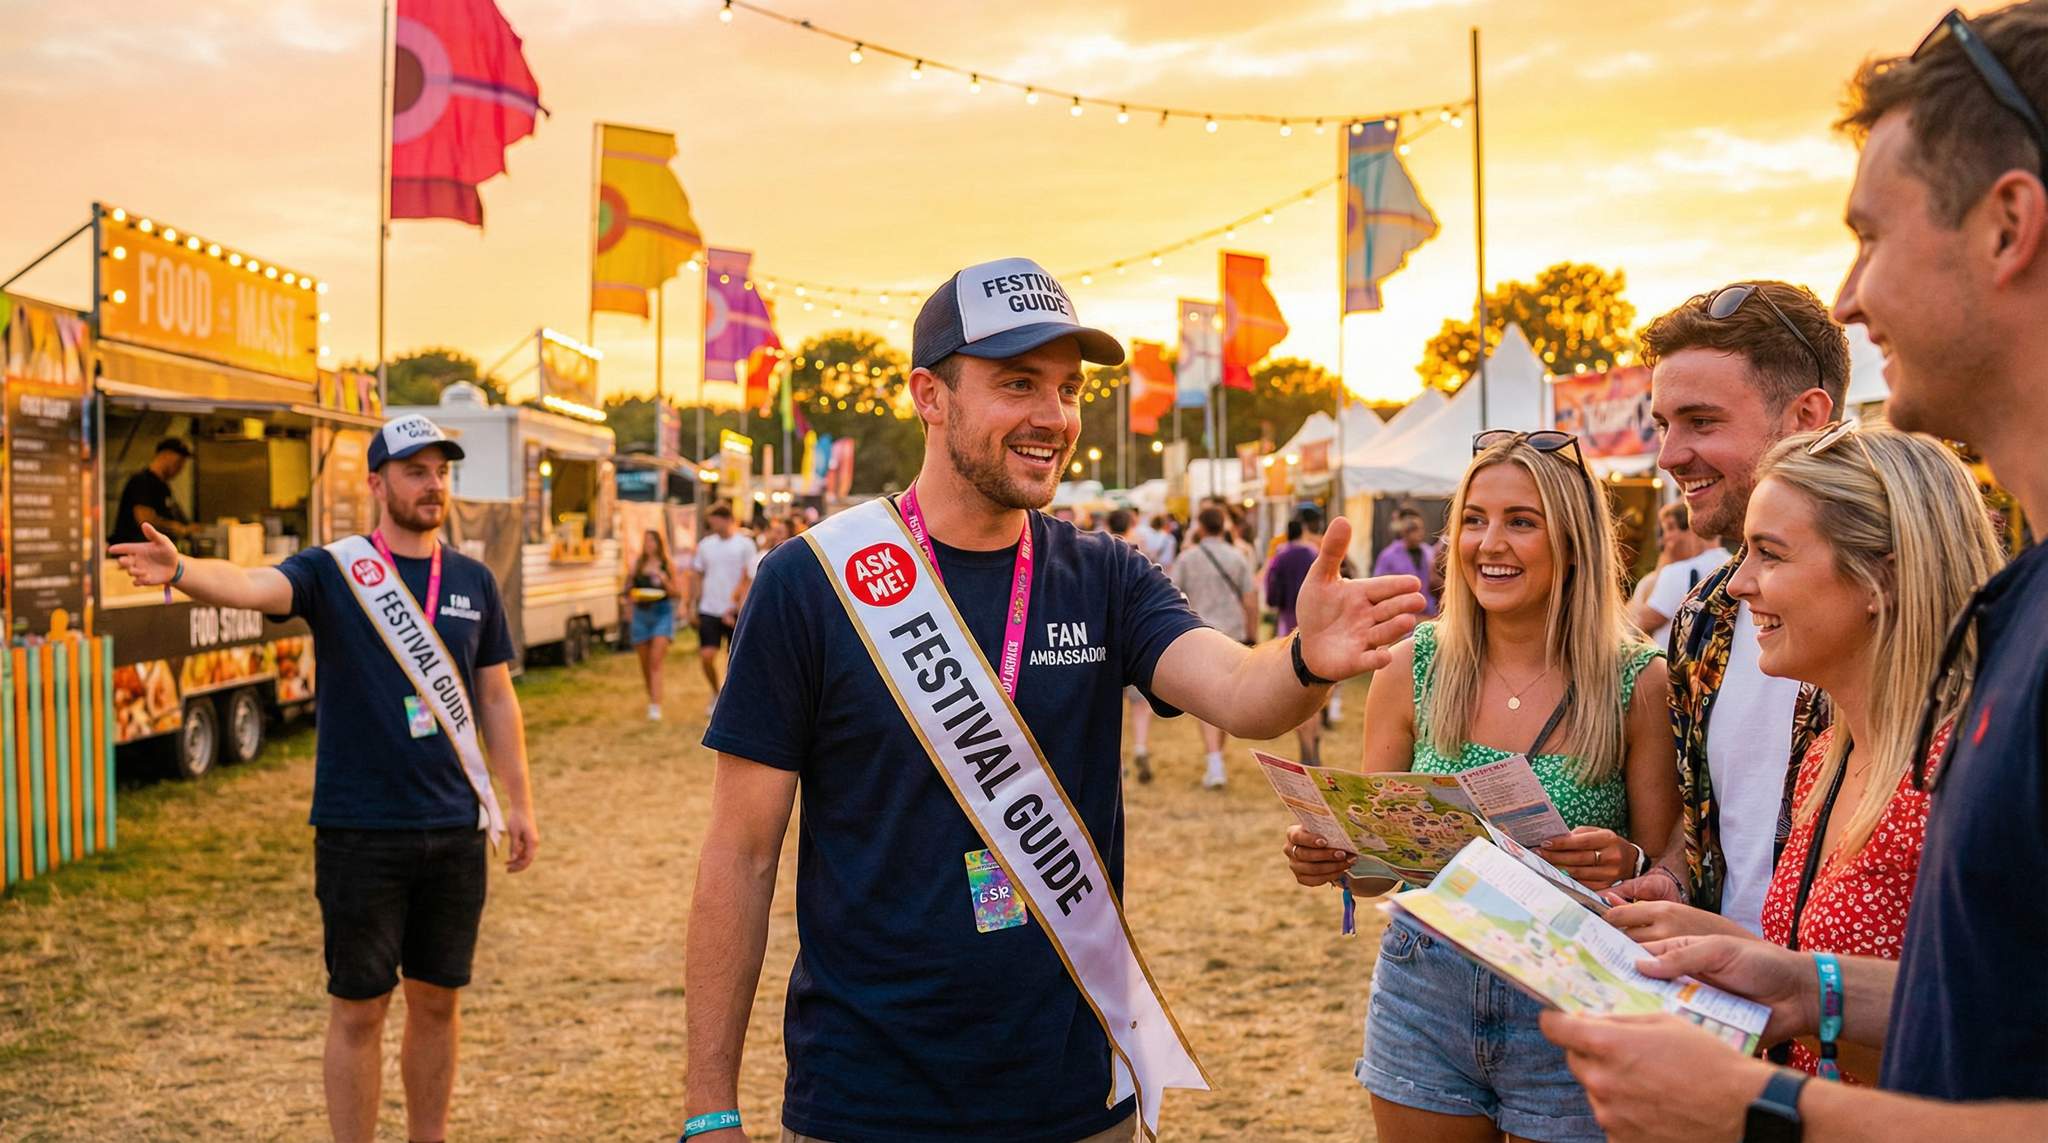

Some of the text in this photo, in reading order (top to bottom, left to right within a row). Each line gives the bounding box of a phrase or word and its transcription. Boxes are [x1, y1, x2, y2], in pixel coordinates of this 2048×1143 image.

[139, 251, 212, 339] FOOD
[982, 273, 1069, 302] FESTIVAL
[1008, 293, 1069, 316] GUIDE
[855, 547, 899, 582] ASK
[866, 569, 909, 602] ME!
[1047, 622, 1088, 648] FAN
[375, 589, 441, 678] FESTIVAL
[432, 674, 469, 733] GUIDE
[1029, 646, 1107, 666] AMBASSADOR
[889, 611, 1094, 917] FESTIVAL GUIDE
